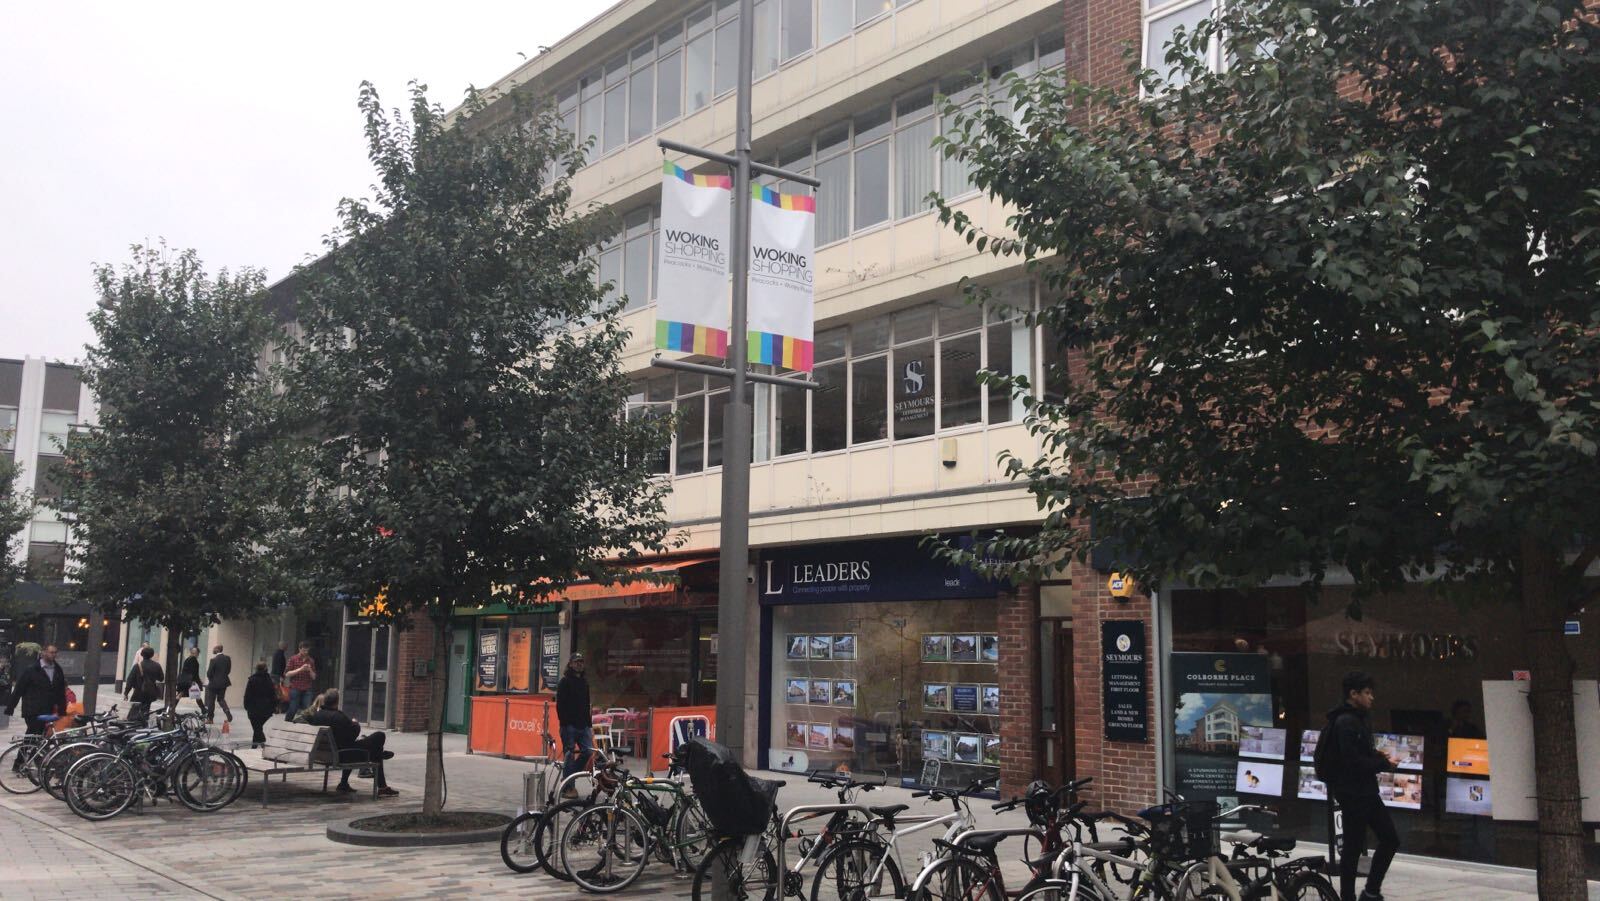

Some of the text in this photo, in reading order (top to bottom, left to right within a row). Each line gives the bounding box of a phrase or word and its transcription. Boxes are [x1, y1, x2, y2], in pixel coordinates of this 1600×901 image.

[666, 229, 719, 251] WOKING
[664, 241, 725, 265] SHOPPING
[753, 246, 806, 268] WOKING
[752, 258, 813, 283] SHOPPING
[895, 396, 934, 411] SEYMOURS
[792, 560, 871, 583] LEADERS
